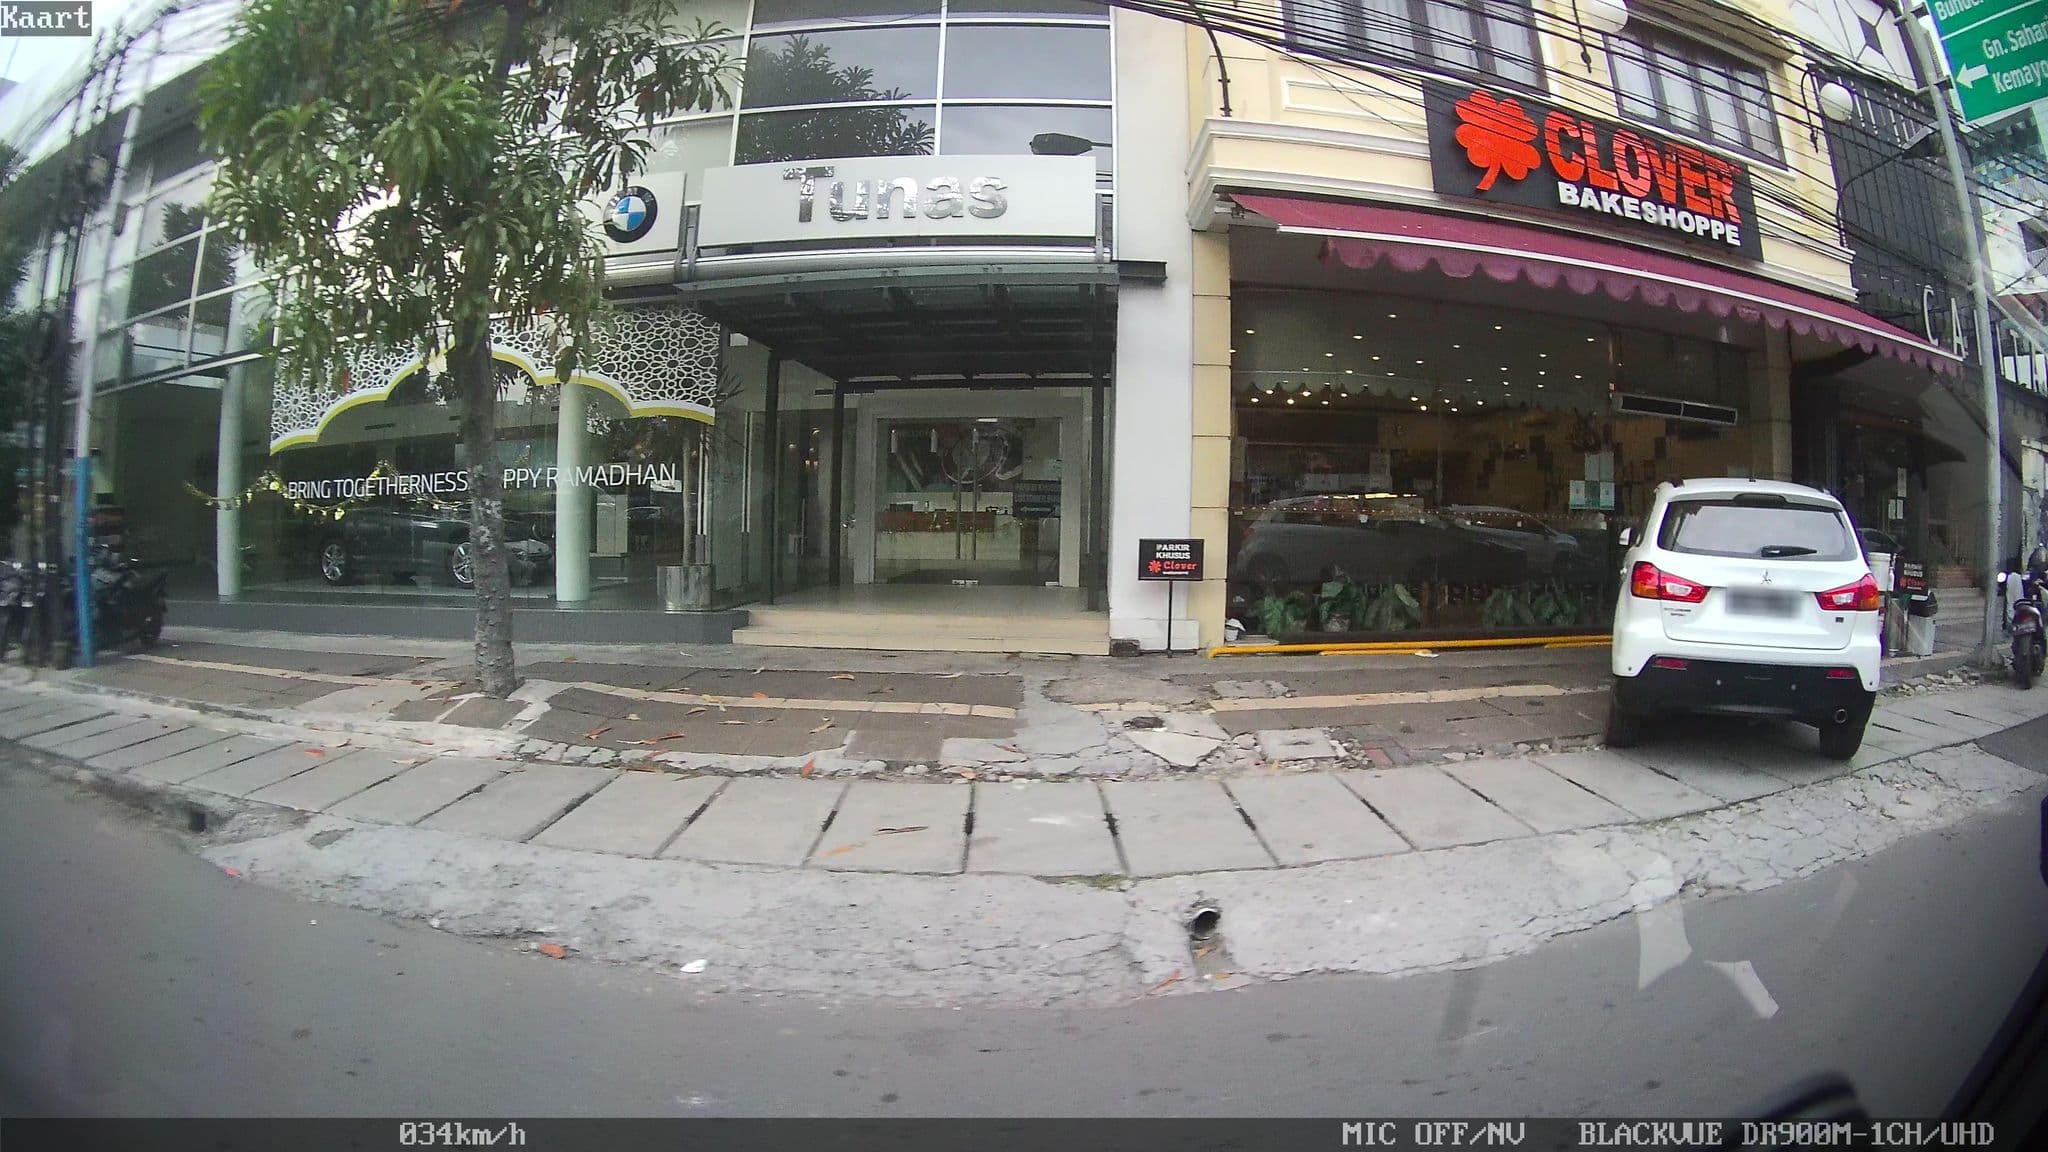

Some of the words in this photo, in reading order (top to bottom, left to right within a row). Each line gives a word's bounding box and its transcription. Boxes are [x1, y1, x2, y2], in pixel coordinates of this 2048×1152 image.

[1983, 38, 2008, 60] Gn.
[2007, 15, 2048, 51] Sahar
[1544, 110, 1742, 224] CLOVER
[783, 166, 1008, 222] Tunas
[1557, 181, 1741, 246] BAKESHOPPE
[288, 479, 331, 500] BRING
[503, 467, 543, 489] PPY
[546, 463, 676, 488] RAMADHAN
[1163, 561, 1197, 570] Clover
